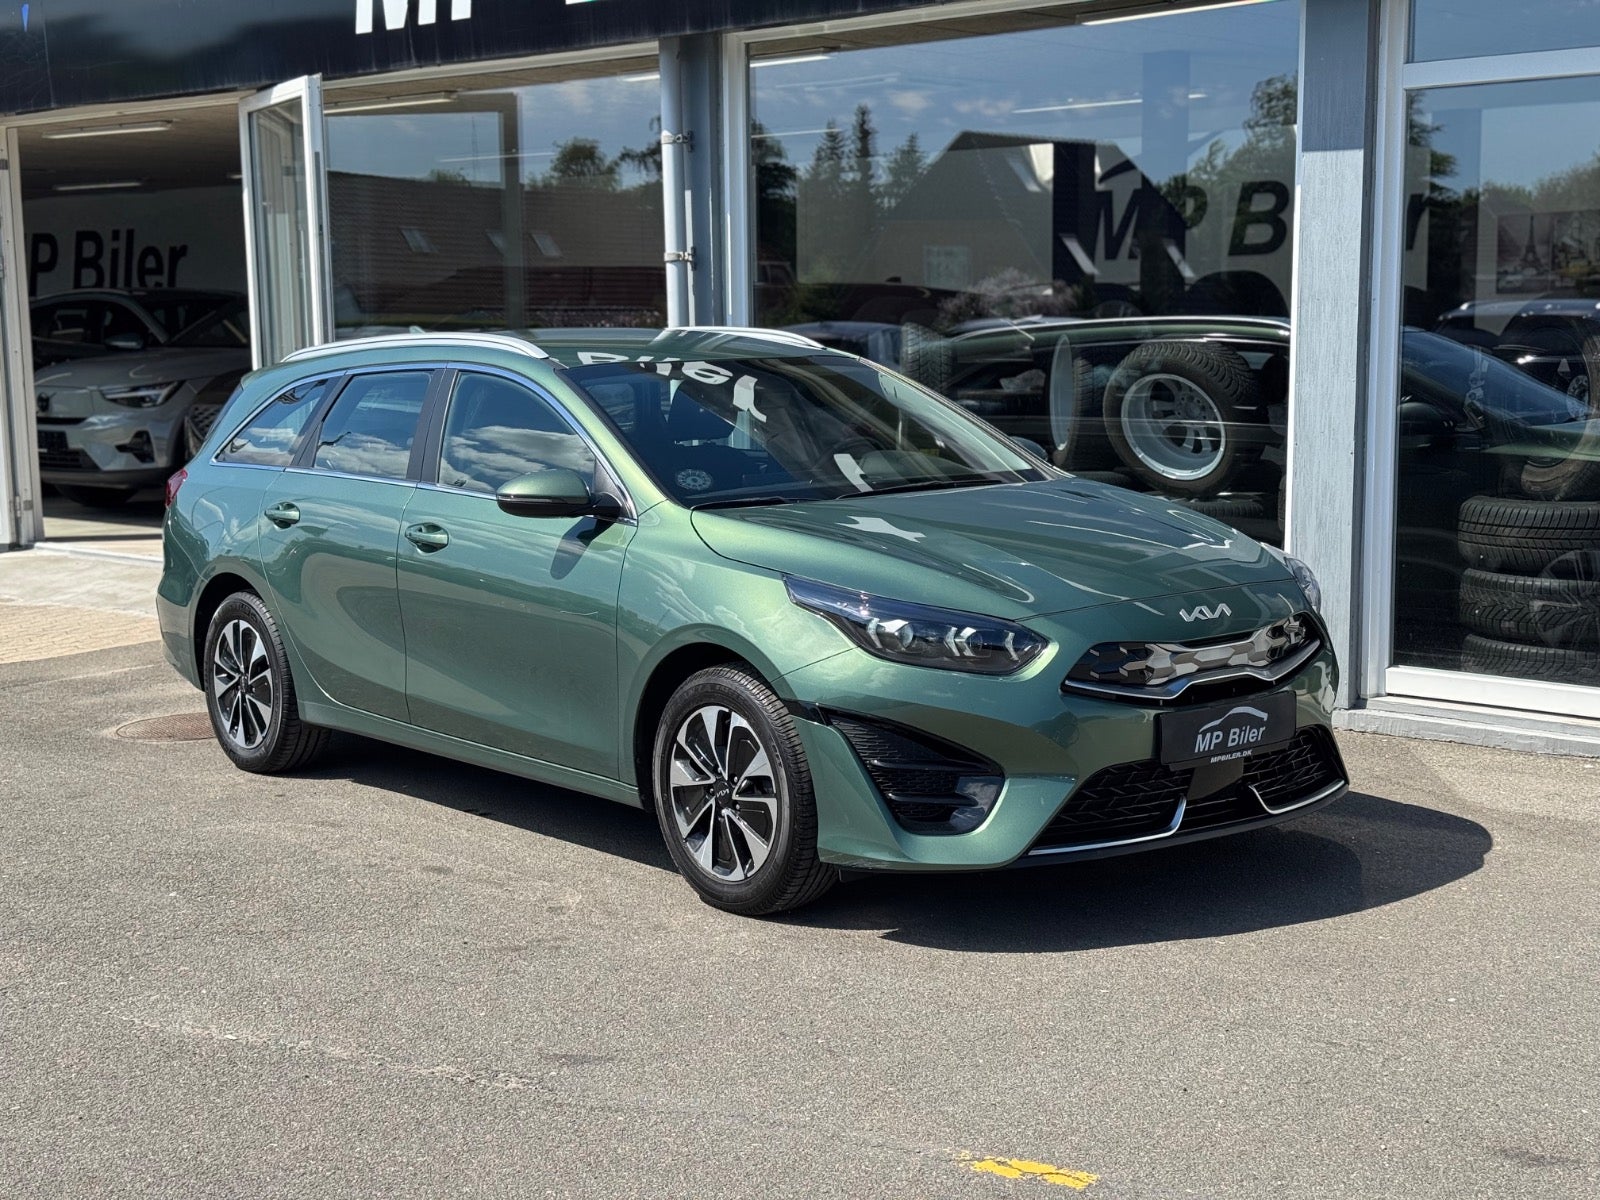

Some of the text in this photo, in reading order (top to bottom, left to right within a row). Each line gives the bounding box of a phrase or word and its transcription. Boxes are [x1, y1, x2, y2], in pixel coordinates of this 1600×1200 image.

[73, 228, 189, 290] Biler
[1179, 603, 1232, 622] KIA
[1194, 725, 1266, 753] MP Biler
[1210, 749, 1253, 763] MPBILER.DK
